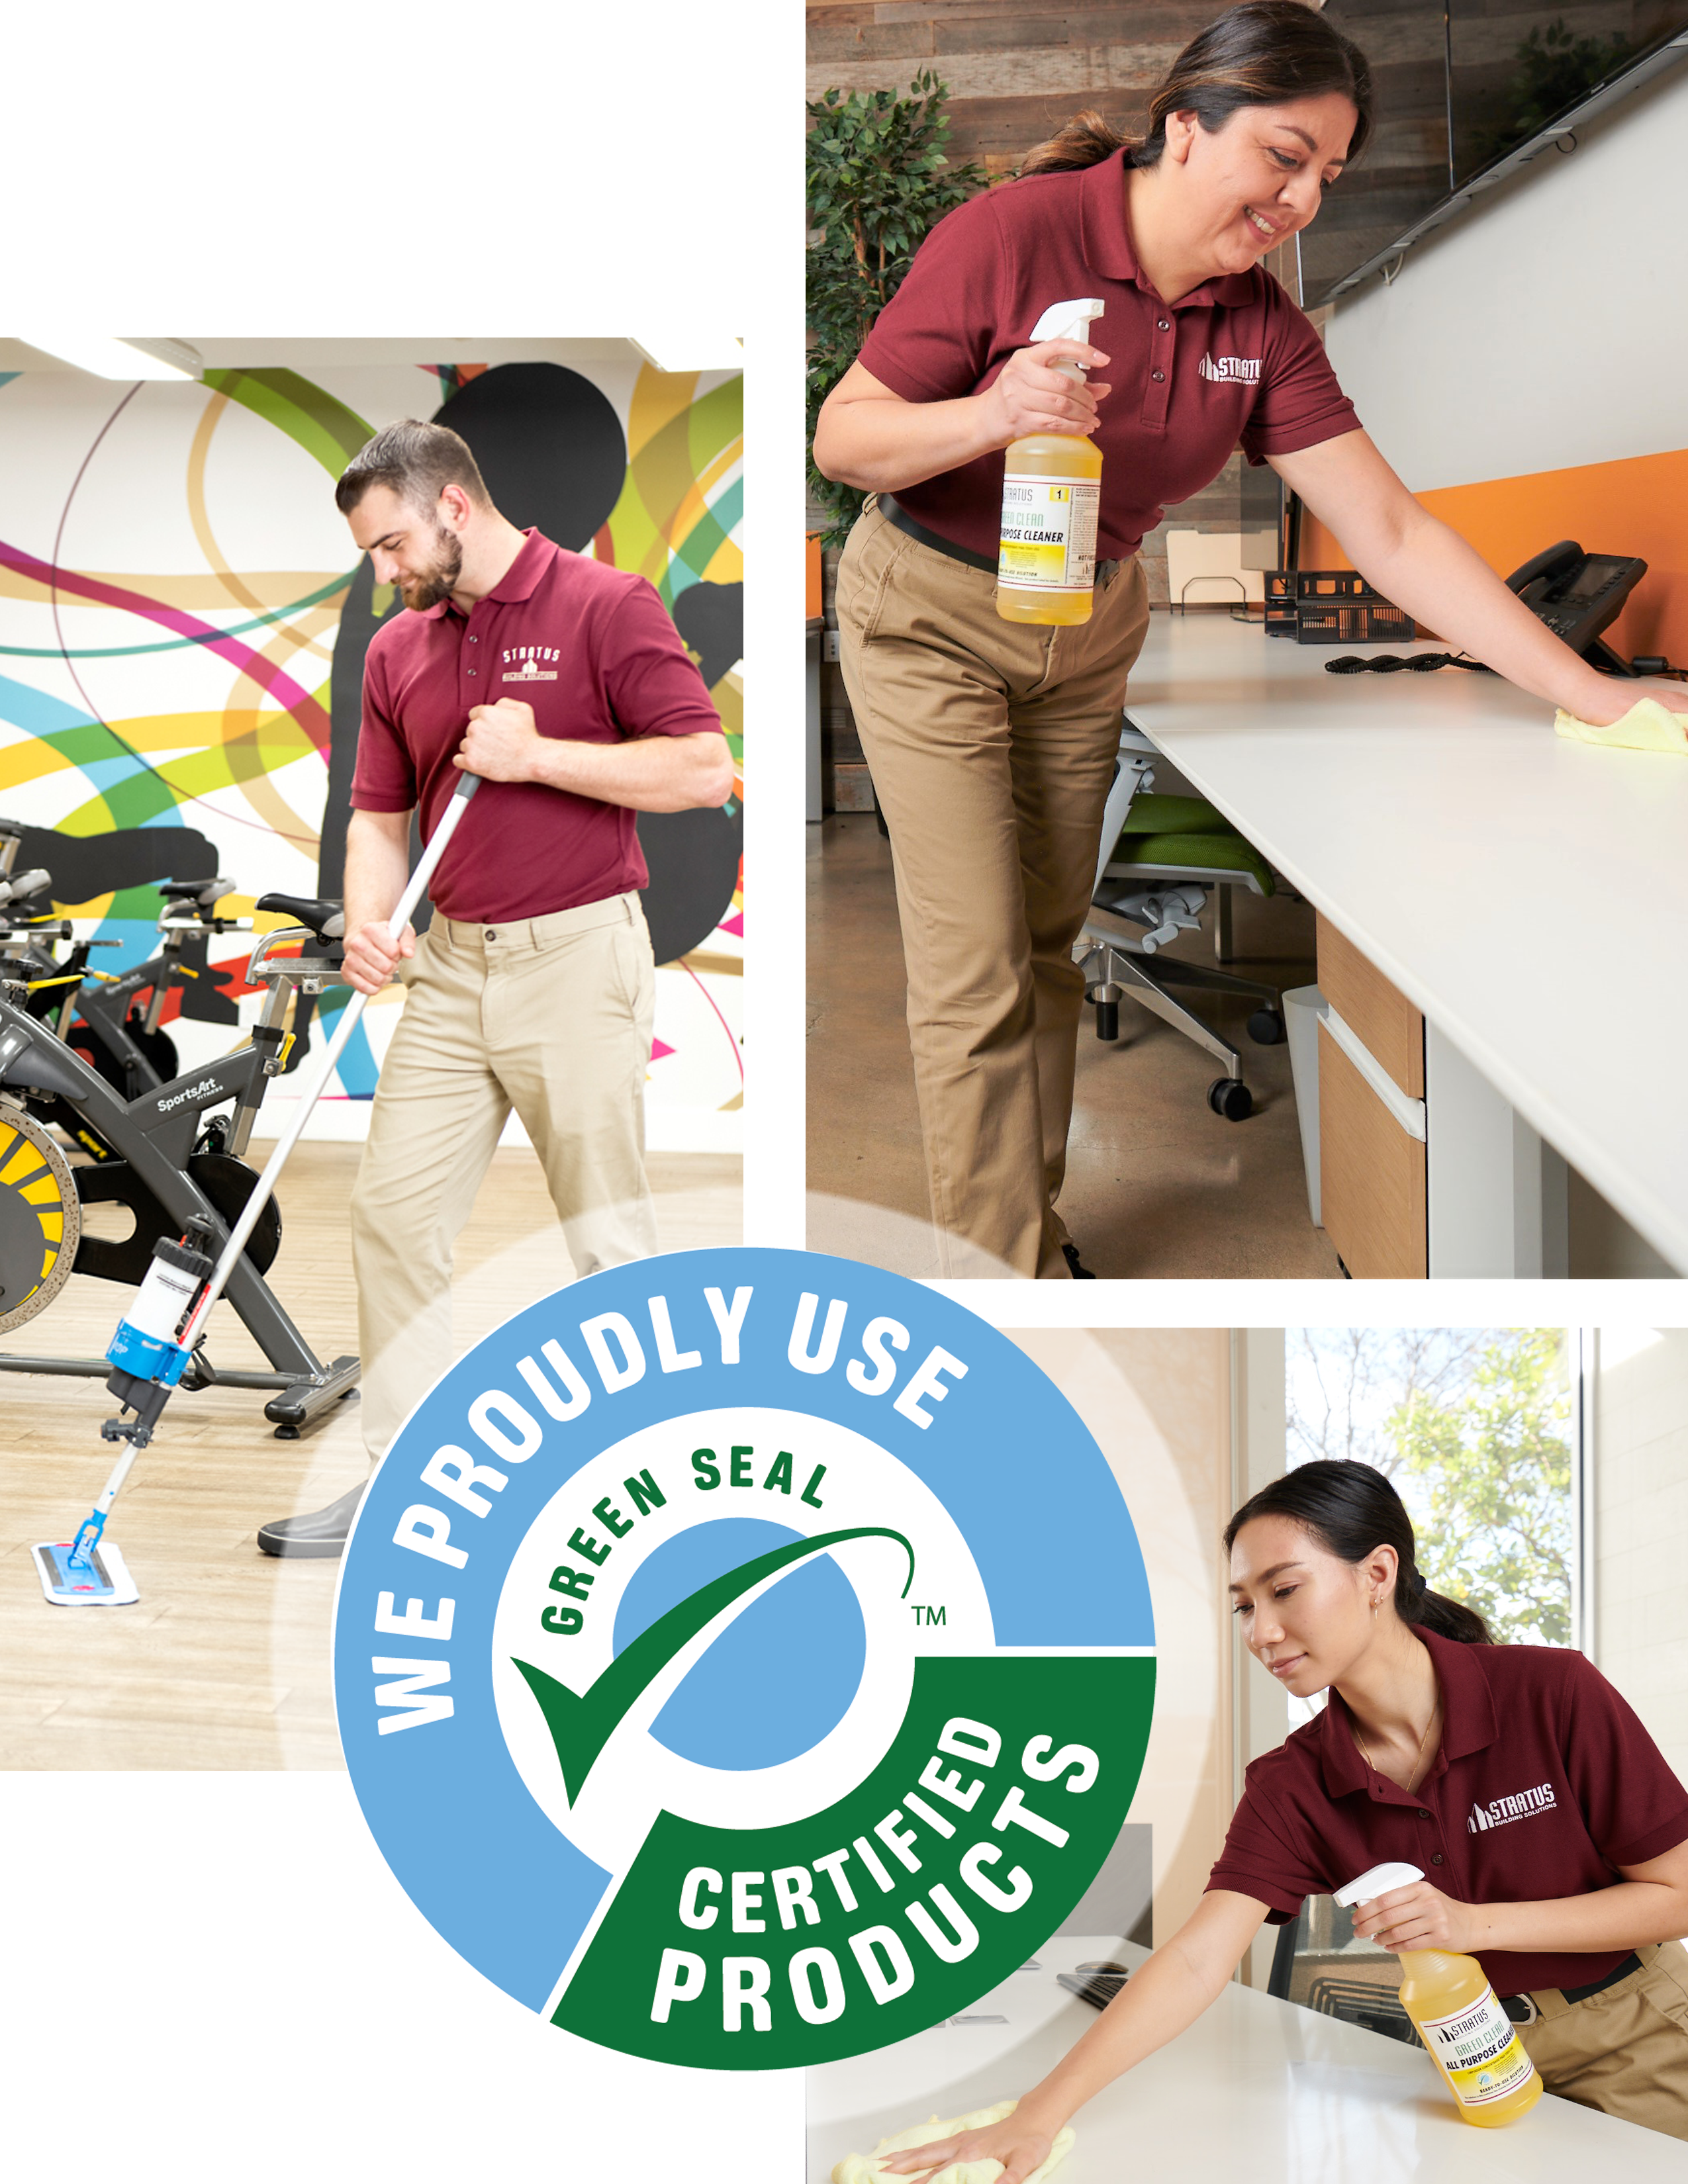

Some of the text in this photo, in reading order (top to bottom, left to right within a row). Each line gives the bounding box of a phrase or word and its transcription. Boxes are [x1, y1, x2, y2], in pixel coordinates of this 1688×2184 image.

[1056, 489, 1062, 500] 1
[1016, 512, 1044, 527] CLEAN
[1024, 530, 1064, 543] CLEANER
[503, 646, 561, 663] STRATUS
[157, 1077, 216, 1113] SportsArt
[1489, 1783, 1555, 1820] STRATUS
[1495, 1802, 1557, 1827] BUILDING SOLUTIONS
[1451, 2009, 1489, 2036] STRATUS
[1454, 2021, 1505, 2056] GREEN CLEAN
[1446, 2060, 1460, 2070] ALL
[1460, 2044, 1498, 2068] PURPOSE
[1479, 2078, 1509, 2093] READY-TO-USE
